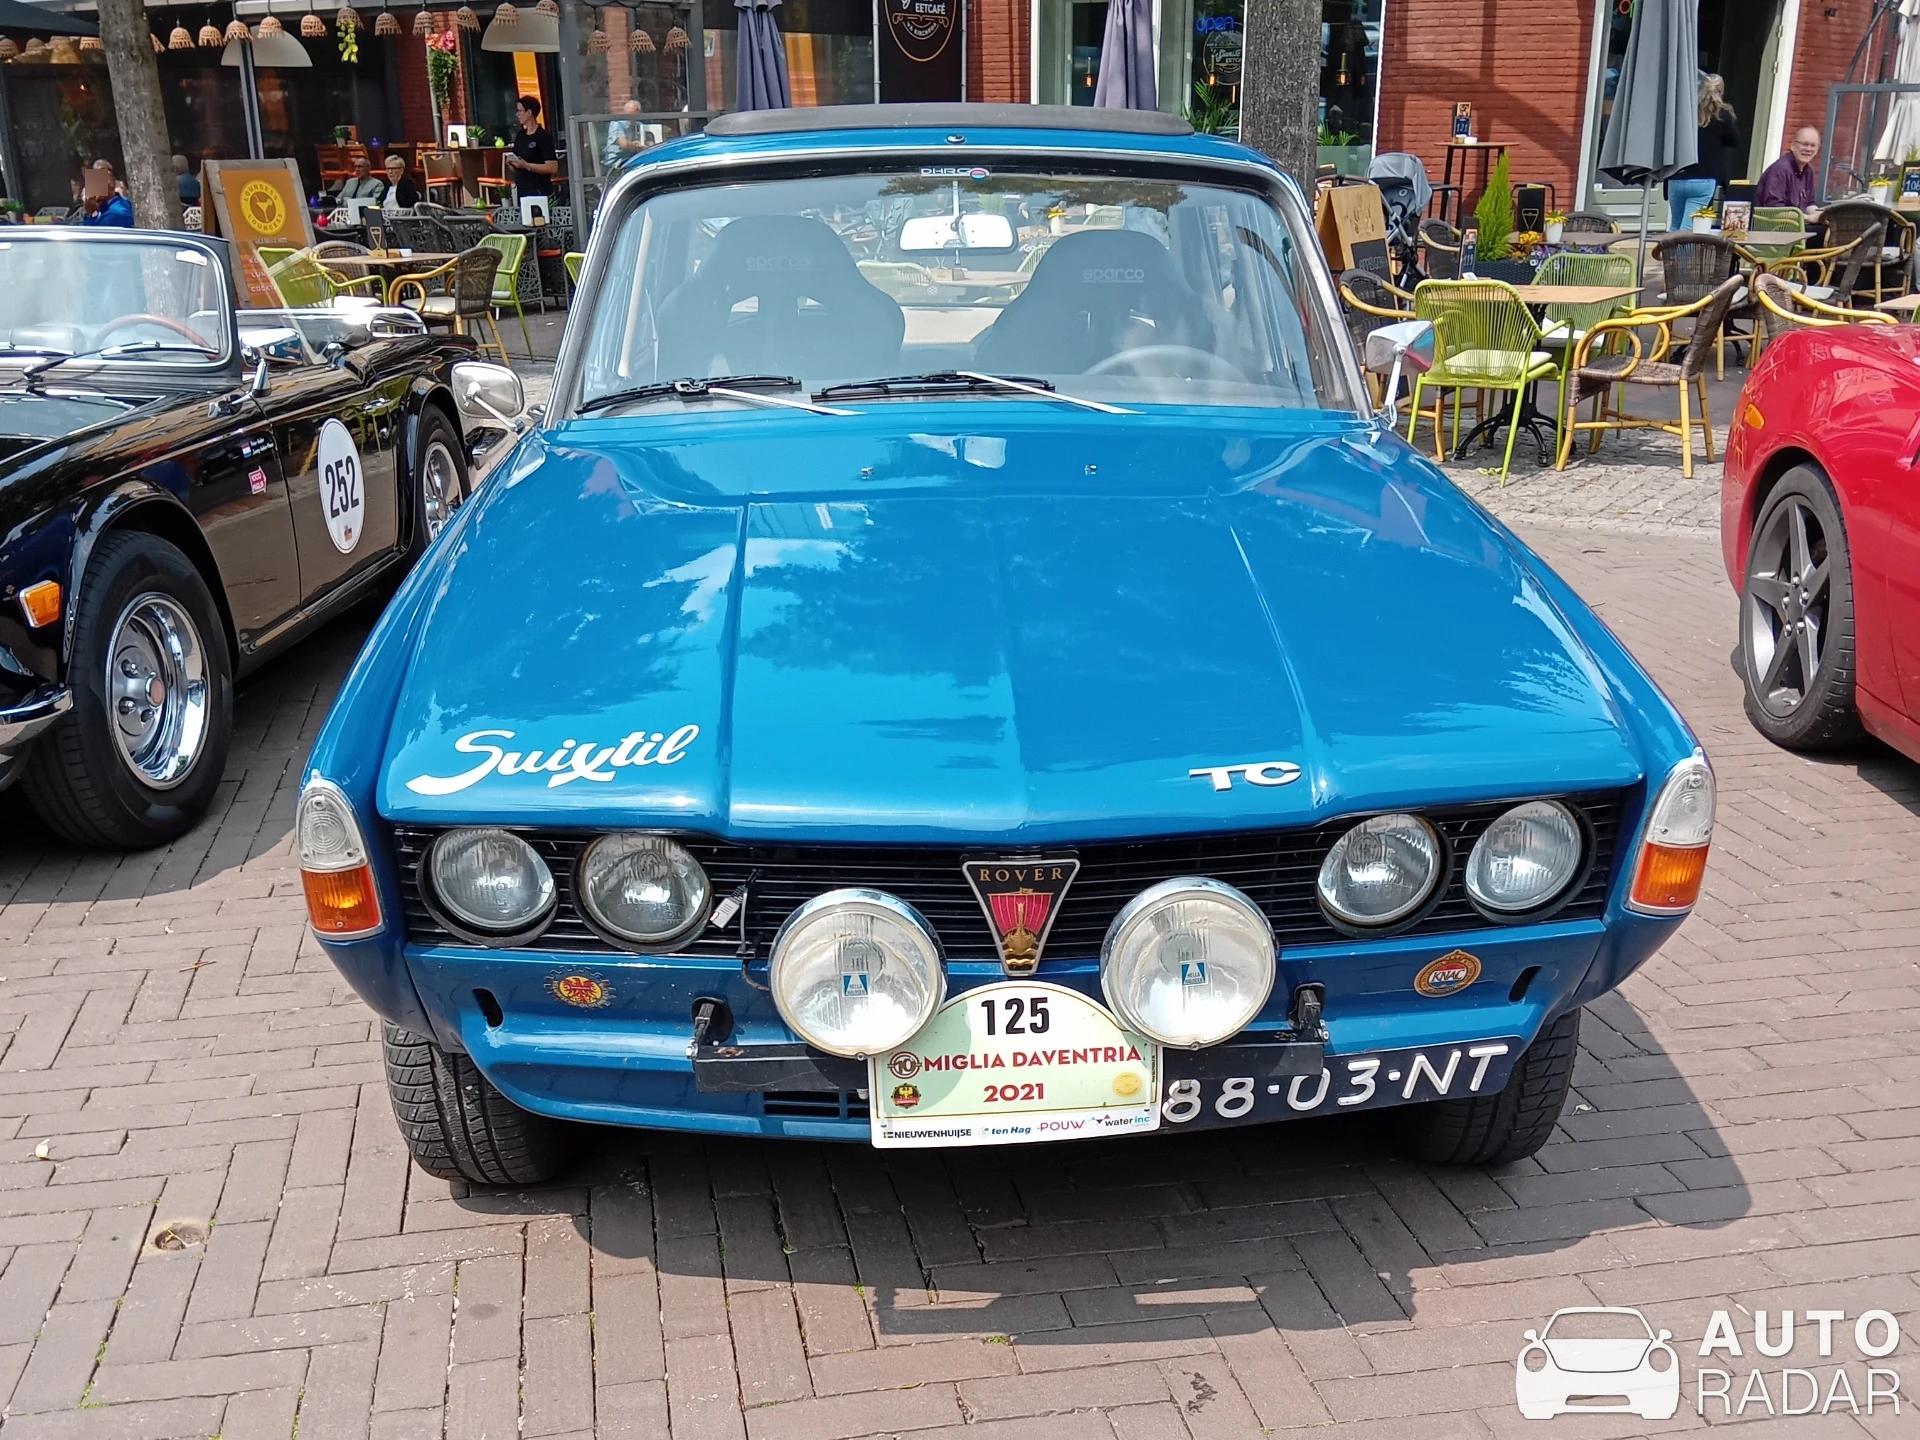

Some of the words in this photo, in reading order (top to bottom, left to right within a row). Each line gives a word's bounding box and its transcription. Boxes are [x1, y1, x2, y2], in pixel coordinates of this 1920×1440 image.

[915, 2, 946, 15] EETCAFÉ
[1196, 16, 1234, 34] open
[243, 183, 278, 202] LOUNGESS
[247, 213, 283, 231] LOUNGESS
[745, 256, 810, 270] sparco
[1082, 267, 1145, 283] sparco
[325, 455, 360, 519] 252
[405, 724, 699, 796] Suixtil
[1188, 761, 1302, 792] TC
[979, 867, 1063, 882] ROVER
[1432, 969, 1465, 982] KNAC
[981, 996, 1050, 1036] 125
[924, 1052, 1007, 1072] MIGLIA
[1012, 1044, 1142, 1068] DAVENTRIA
[983, 1083, 1045, 1103] 2021
[1039, 1119, 1086, 1132] POUW
[1104, 1118, 1133, 1127] water
[1134, 1115, 1151, 1124] inc
[894, 1128, 972, 1139] NIEUWENHUIJSE
[1010, 1126, 1031, 1135] Hag
